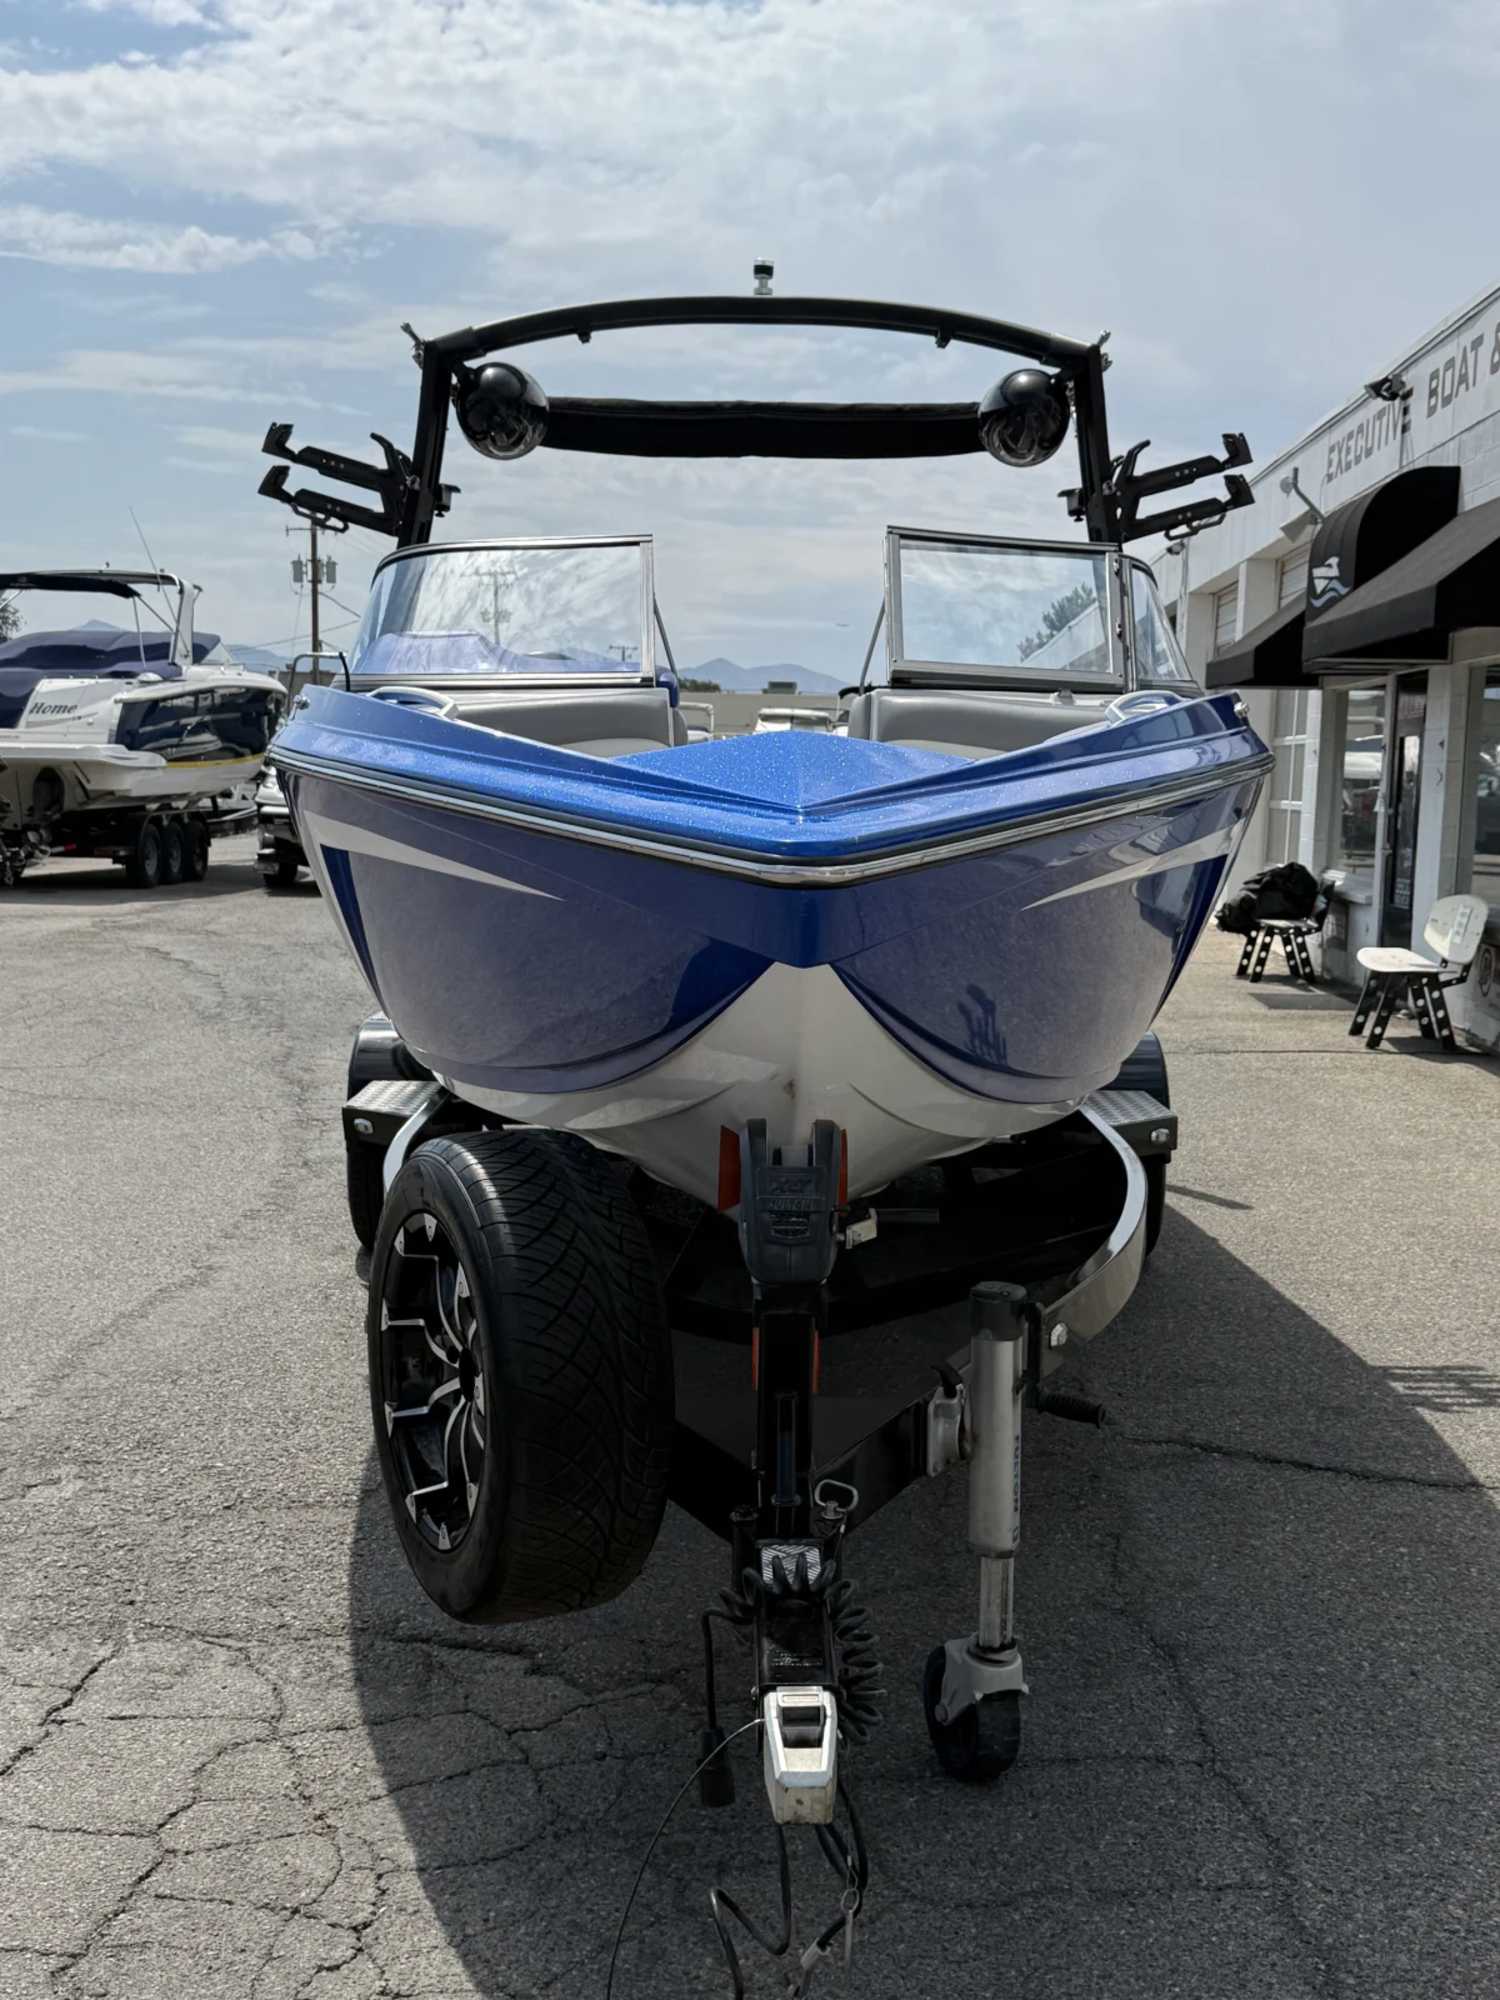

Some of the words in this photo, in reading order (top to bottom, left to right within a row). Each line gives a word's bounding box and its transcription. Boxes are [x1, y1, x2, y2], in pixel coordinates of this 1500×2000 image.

[1326, 386, 1414, 484] EXECUTIVE
[1426, 333, 1484, 419] BOAT
[29, 702, 78, 715] Home
